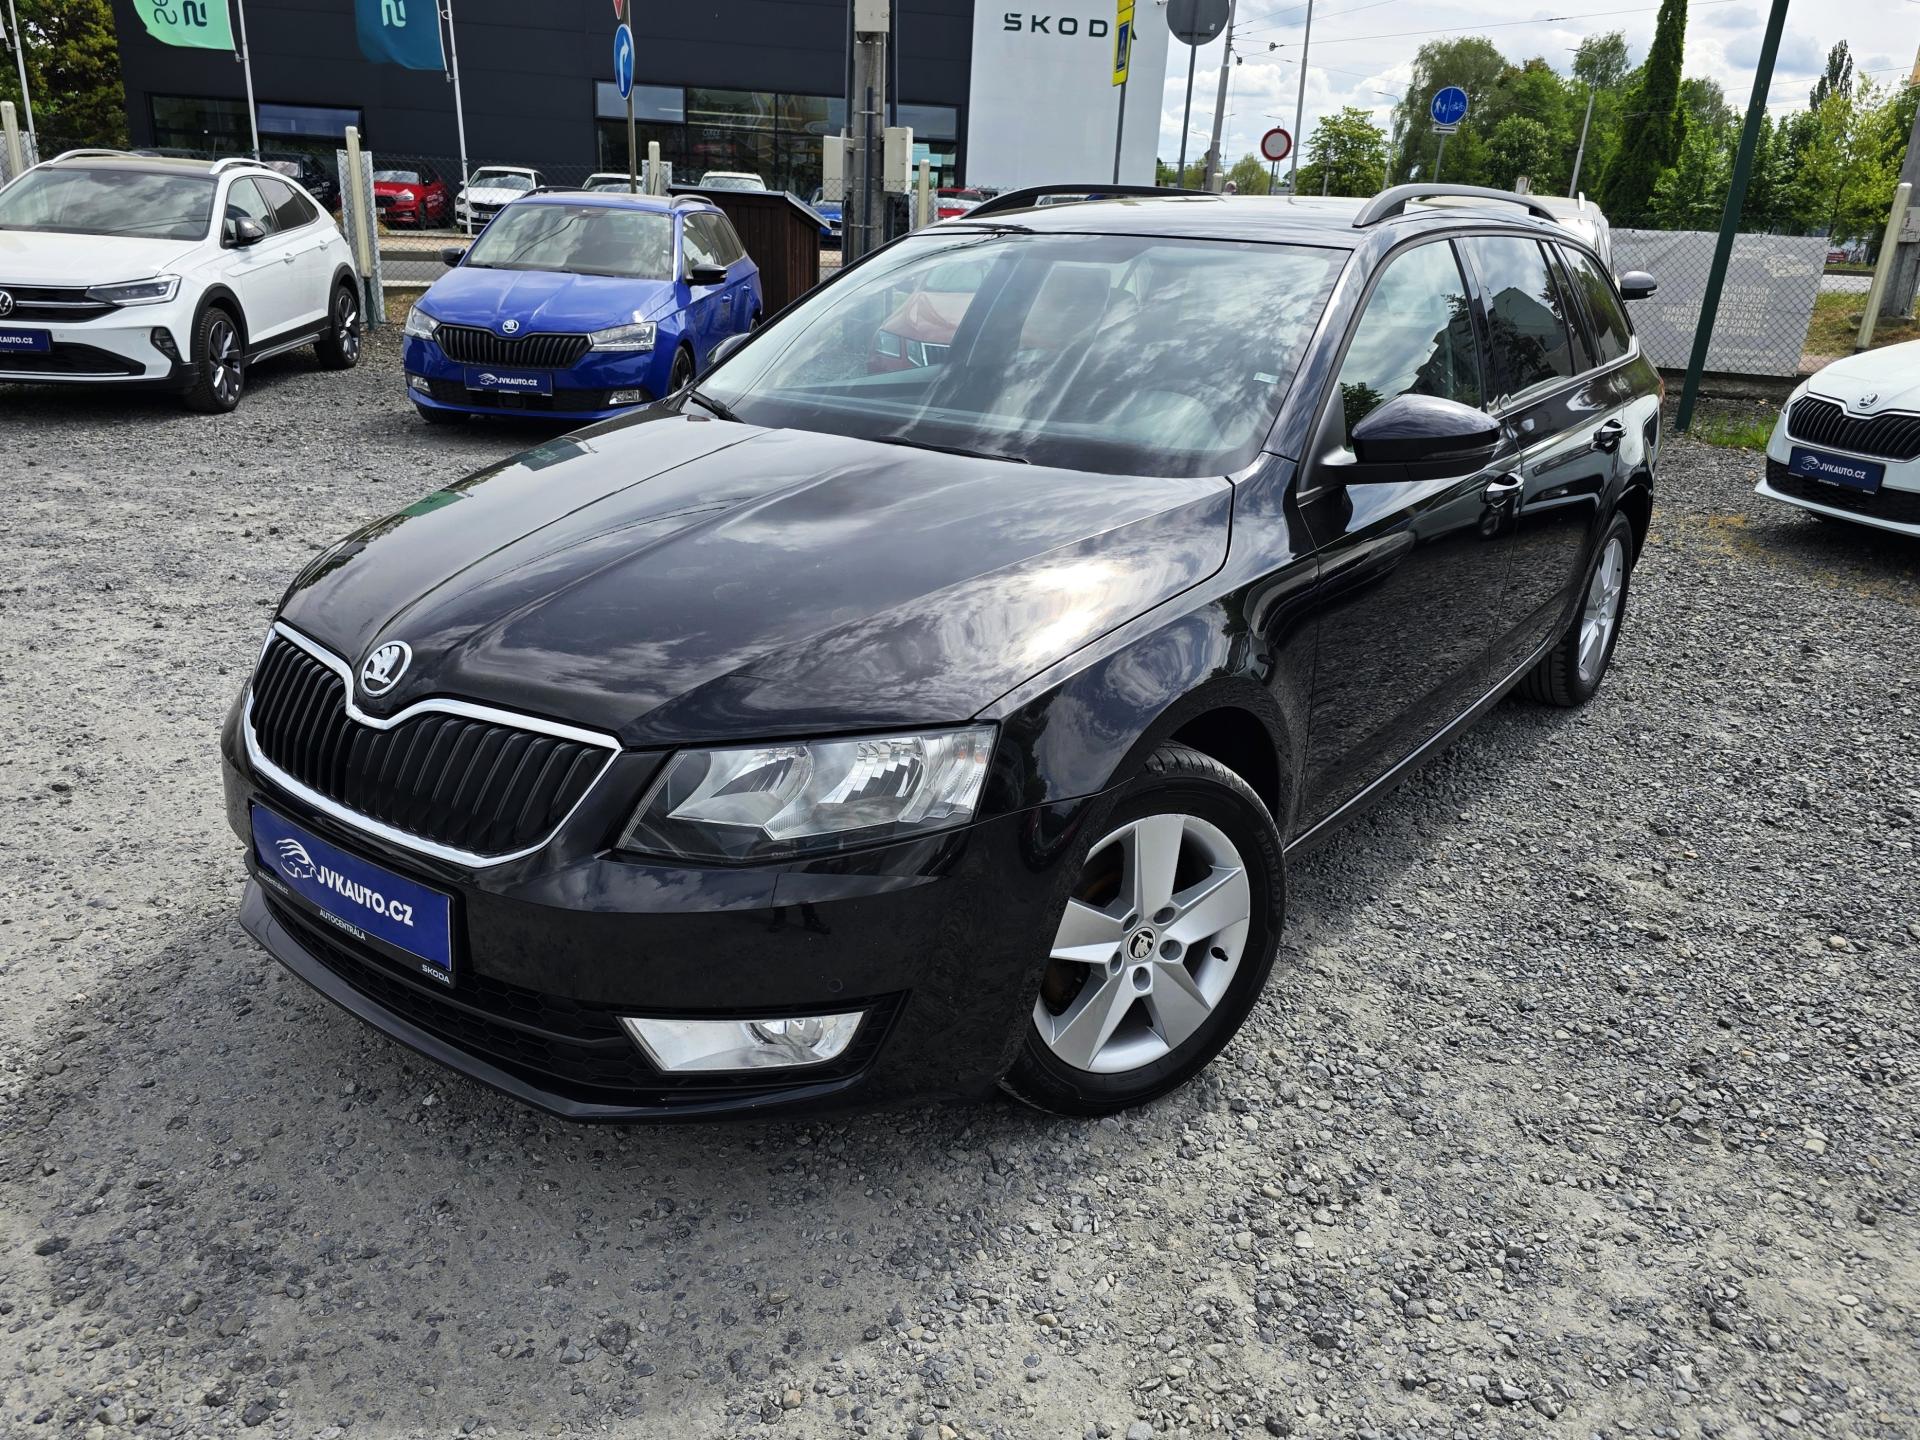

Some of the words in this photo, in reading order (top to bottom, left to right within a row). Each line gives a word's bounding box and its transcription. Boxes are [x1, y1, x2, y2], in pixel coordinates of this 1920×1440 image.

[1003, 12, 1137, 40] SKOD
[497, 377, 538, 386] JVKAUTO.CZ
[1819, 463, 1866, 480] JVKAUTO.CZ
[317, 865, 414, 927] JVKAUTO.CZ
[319, 908, 366, 941] AUTOCENTRÁLA
